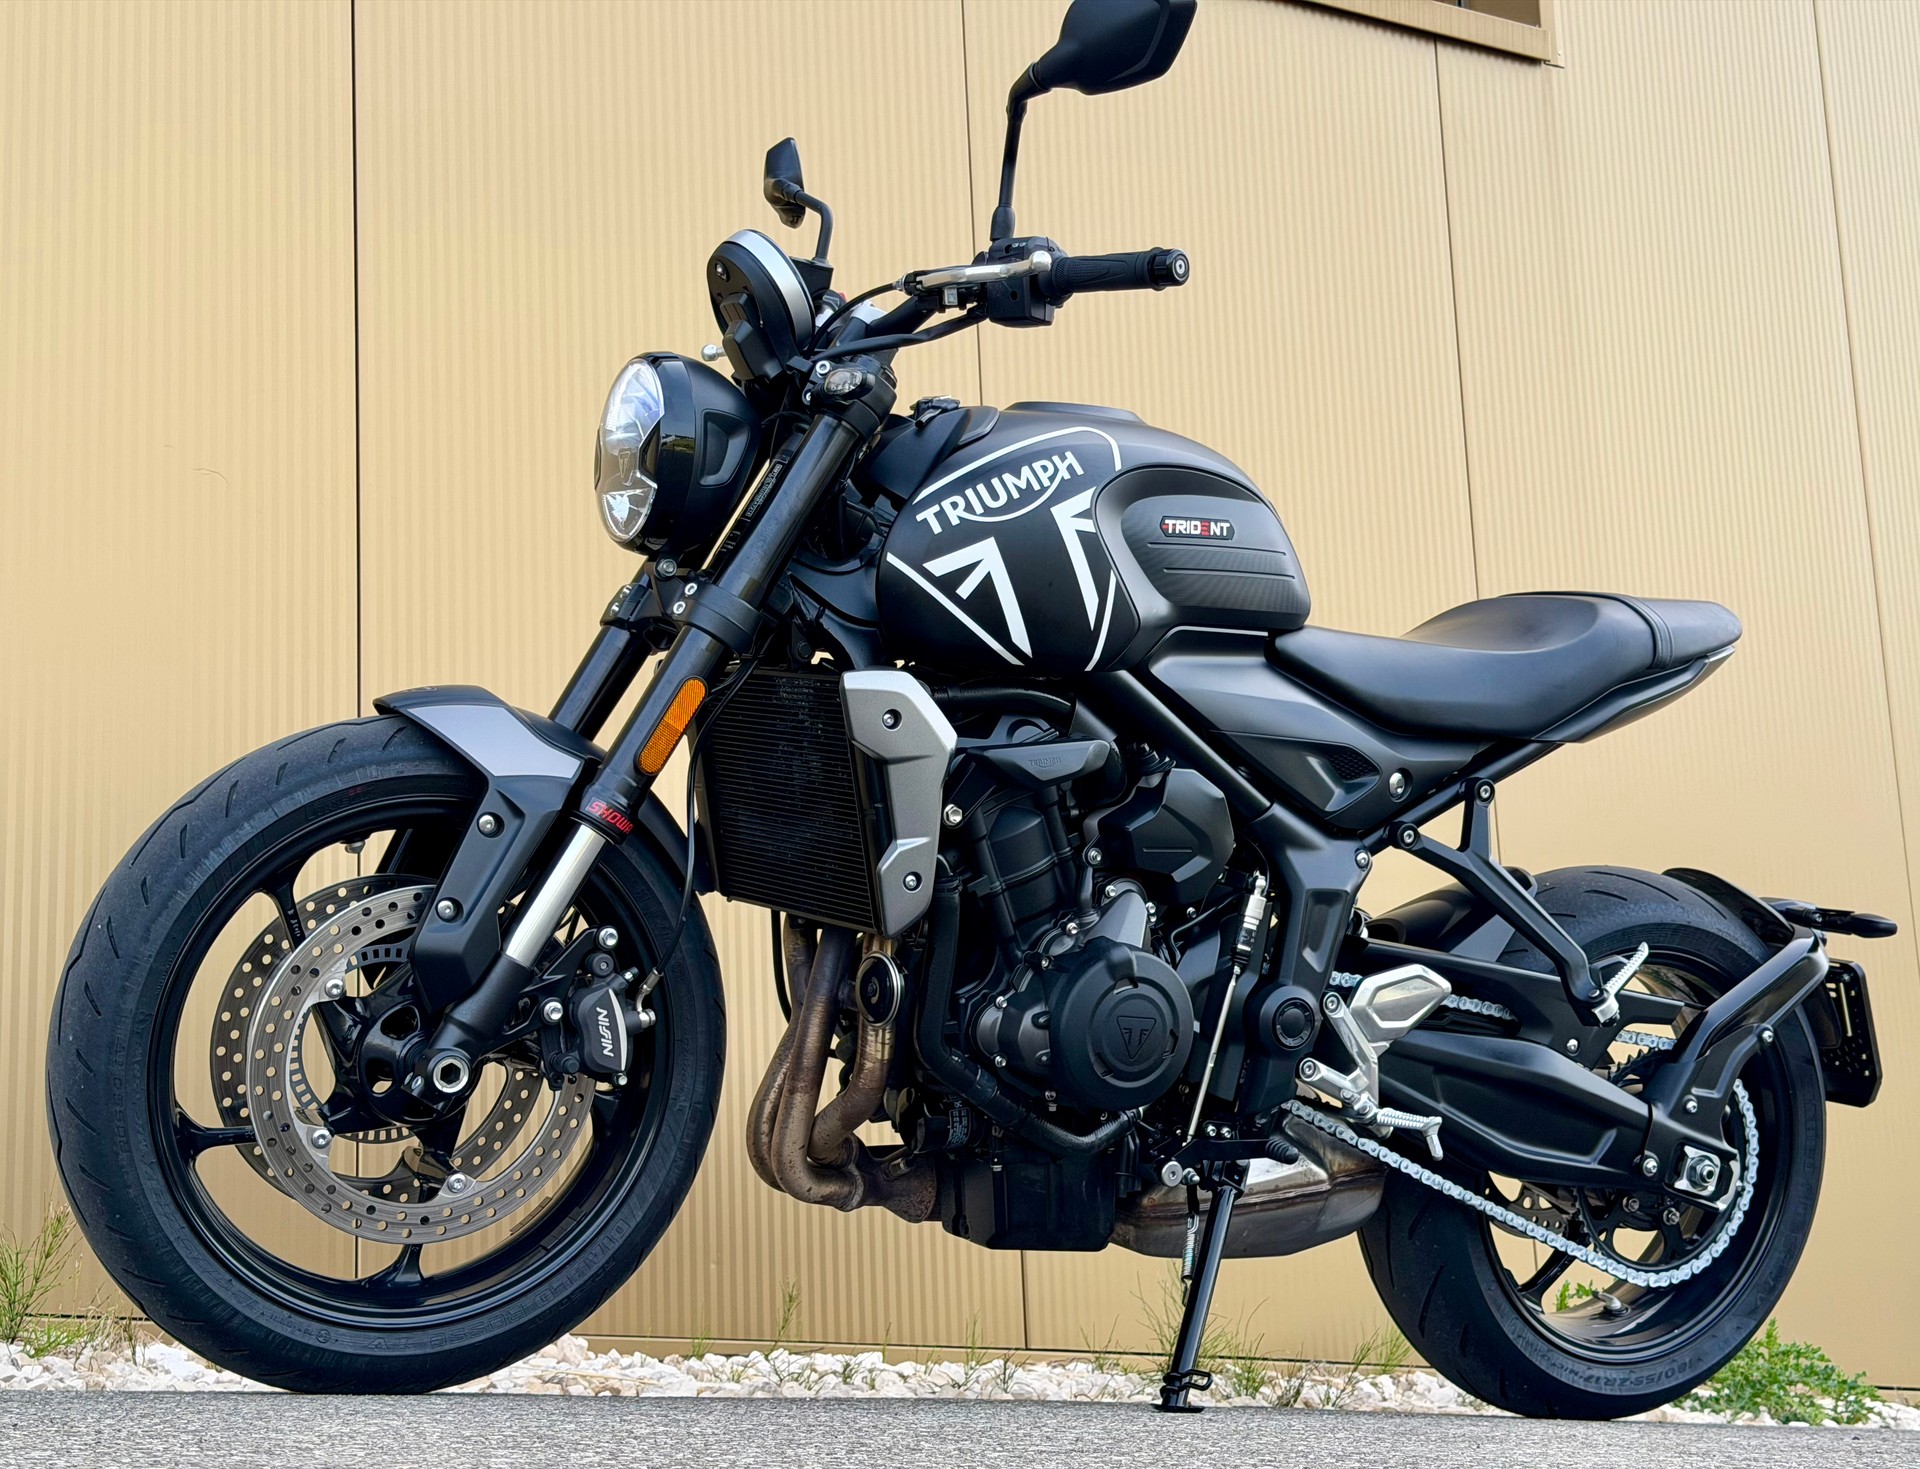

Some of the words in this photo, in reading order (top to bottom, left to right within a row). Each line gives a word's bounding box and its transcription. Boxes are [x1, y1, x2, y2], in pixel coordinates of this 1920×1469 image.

[915, 450, 1085, 535] TRIUMPH
[1164, 519, 1231, 537] TRIDENT
[588, 801, 634, 835] SHOWA
[596, 1006, 615, 1057] NISSIN
